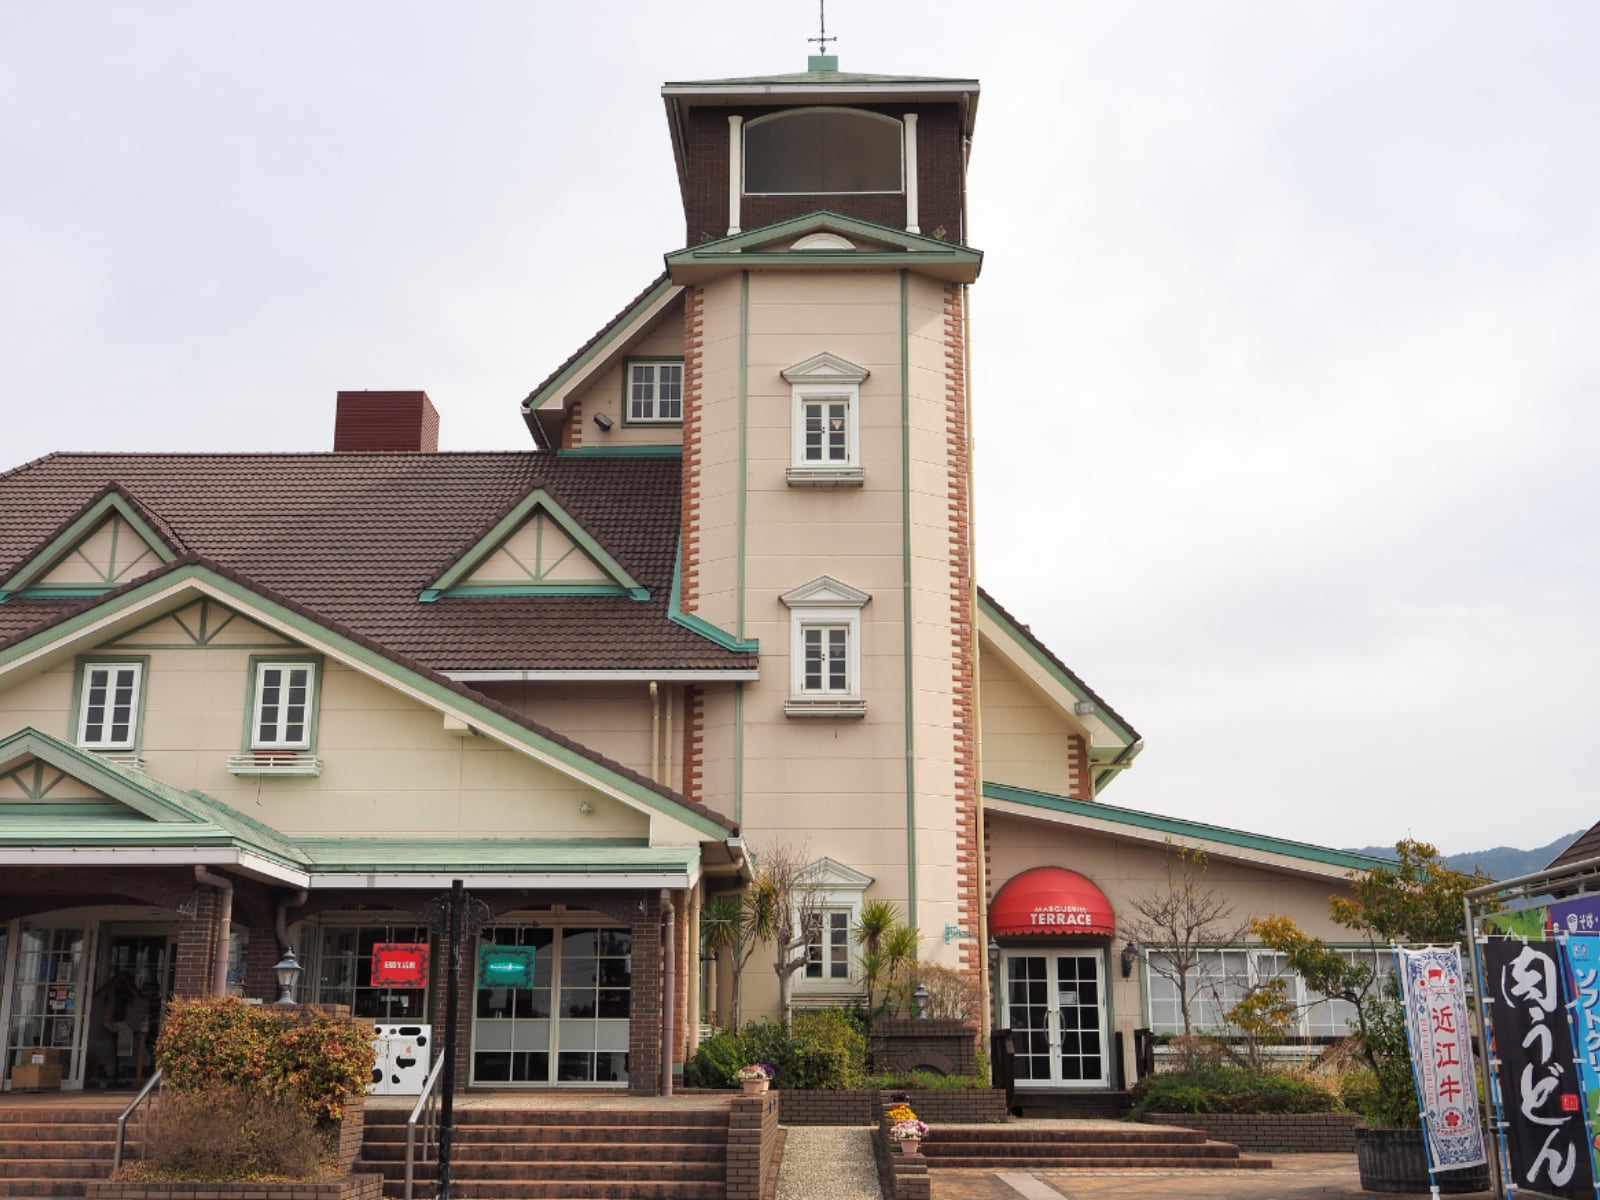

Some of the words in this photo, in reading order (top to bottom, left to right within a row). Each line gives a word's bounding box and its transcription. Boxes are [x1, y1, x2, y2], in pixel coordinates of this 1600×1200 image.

[1030, 913, 1092, 926] TERRACE
[1432, 1005, 1462, 1104] 近江牛
